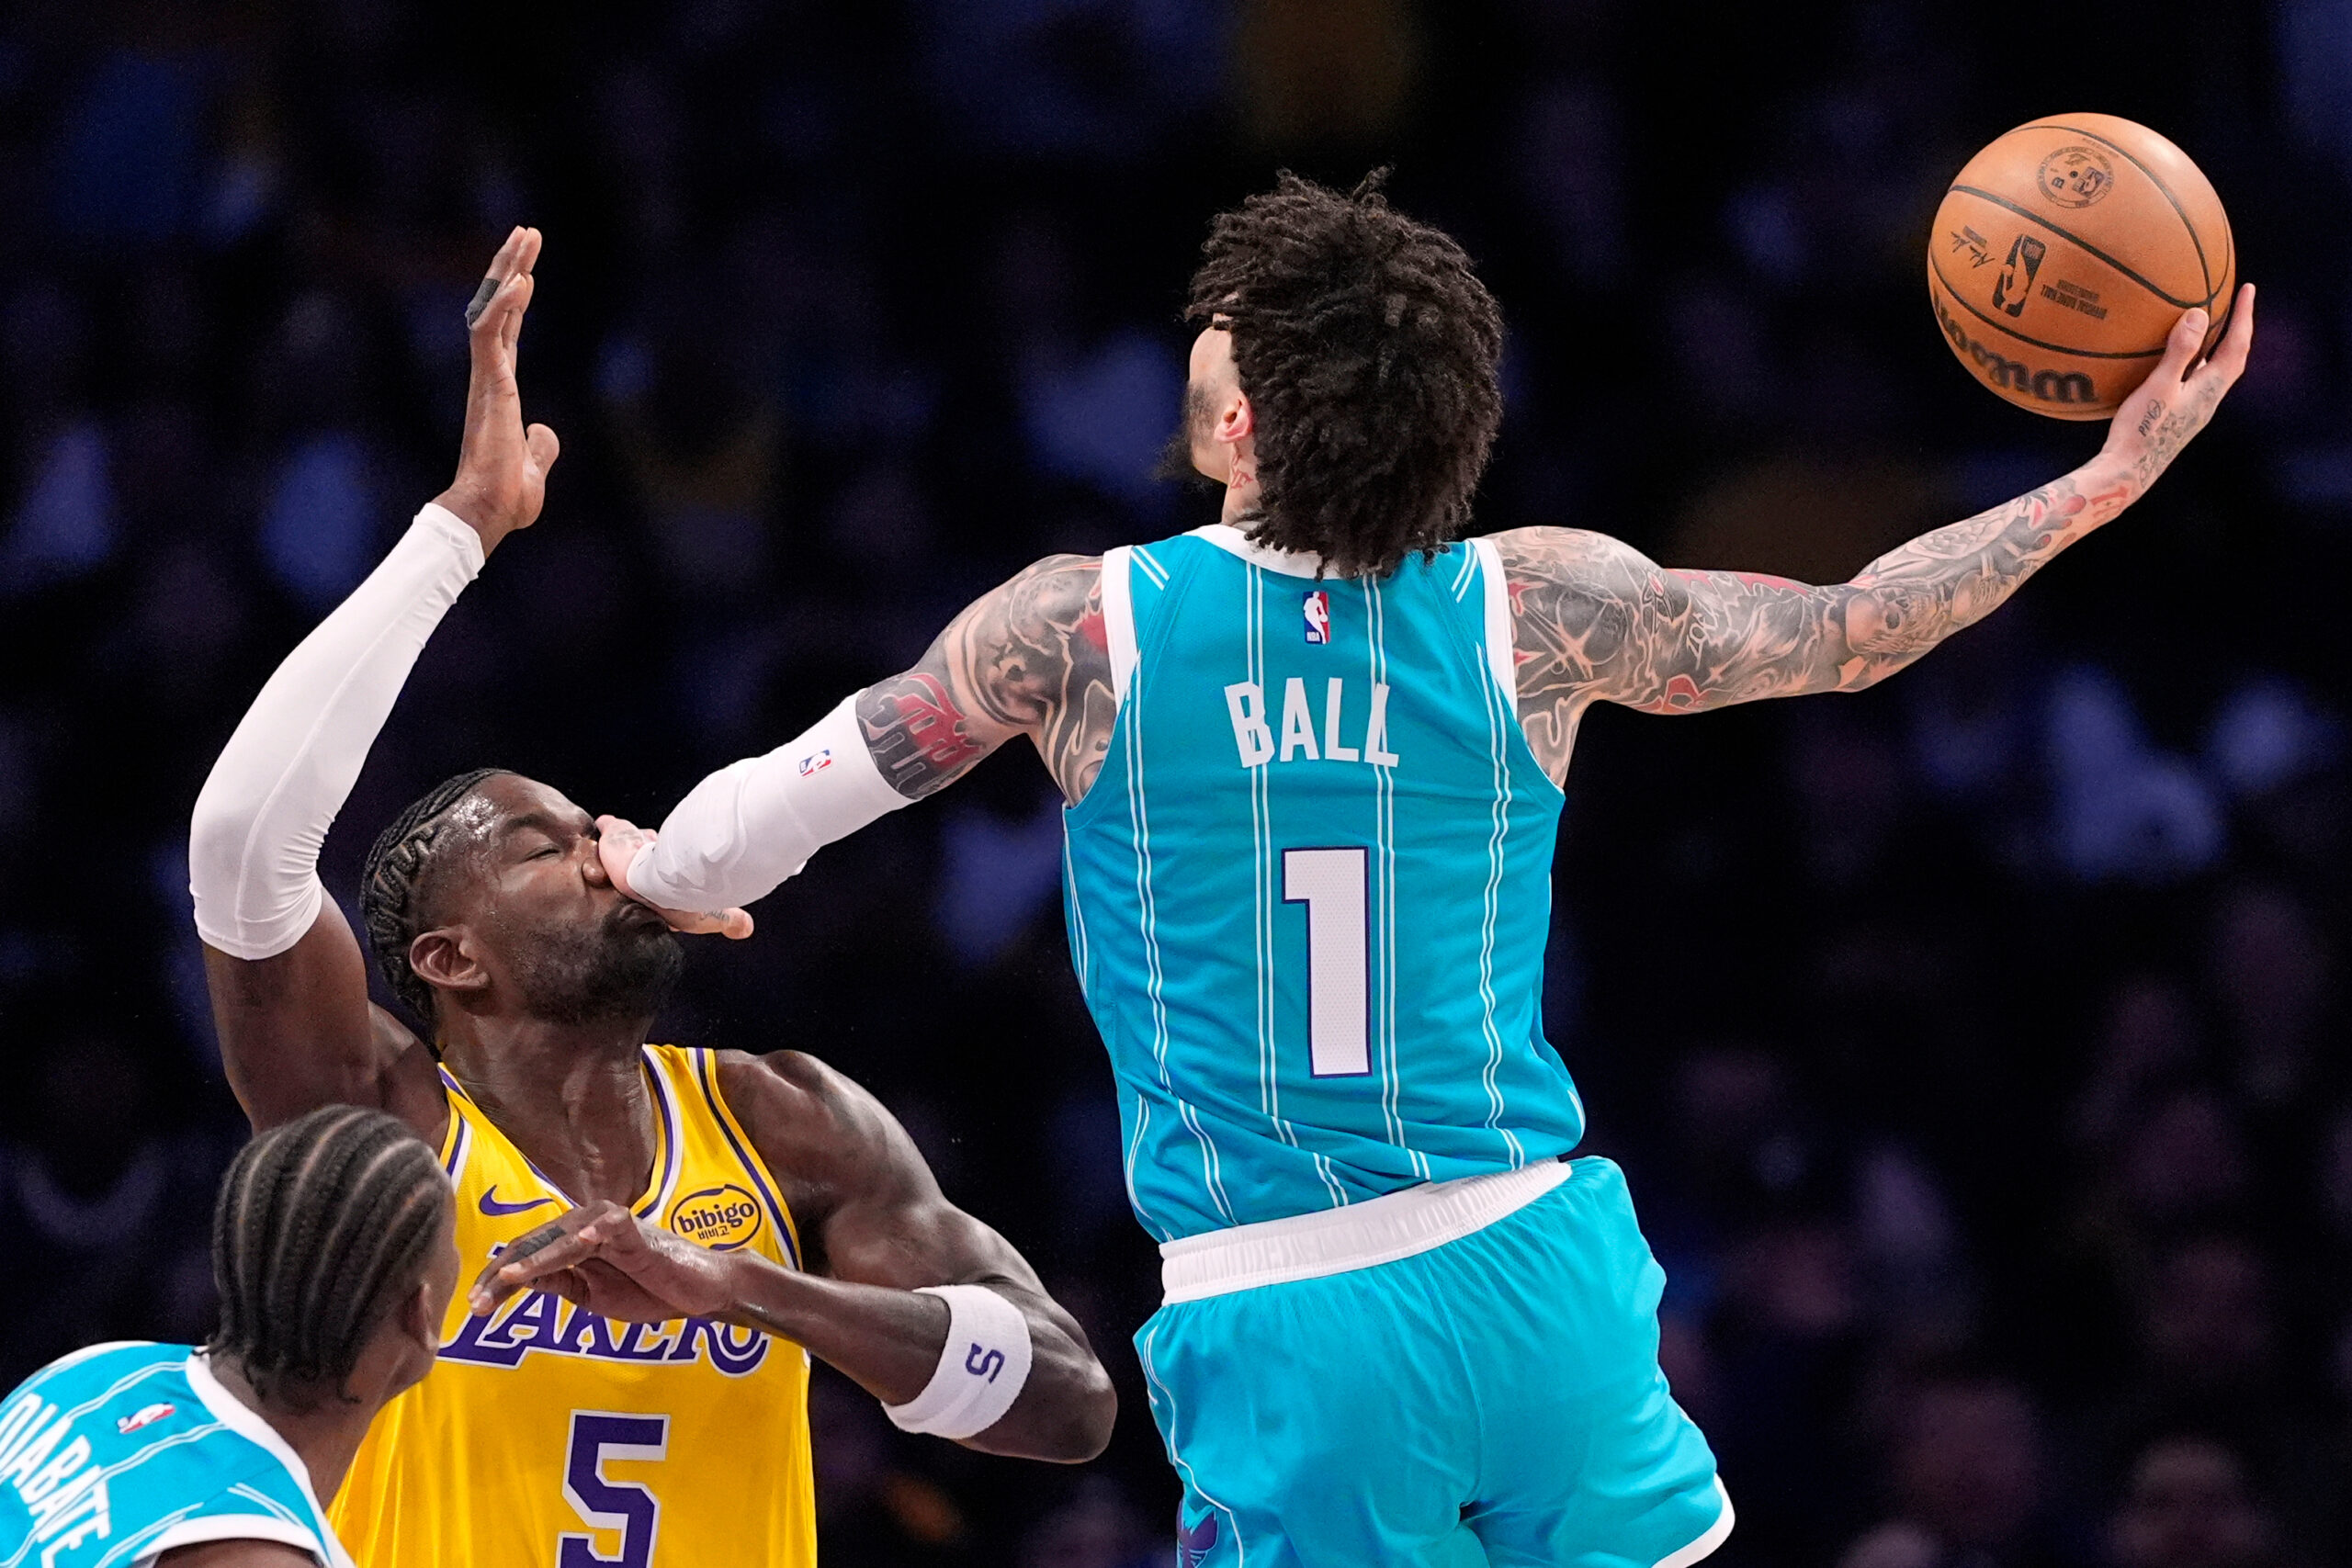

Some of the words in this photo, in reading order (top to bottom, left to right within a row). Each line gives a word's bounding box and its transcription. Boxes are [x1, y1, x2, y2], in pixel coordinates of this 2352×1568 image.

[1224, 677, 1399, 768] BALL
[1281, 846, 1372, 1077] 1
[677, 1202, 755, 1234] bibigo
[697, 1224, 730, 1240] 비비고
[554, 1408, 671, 1568] 5
